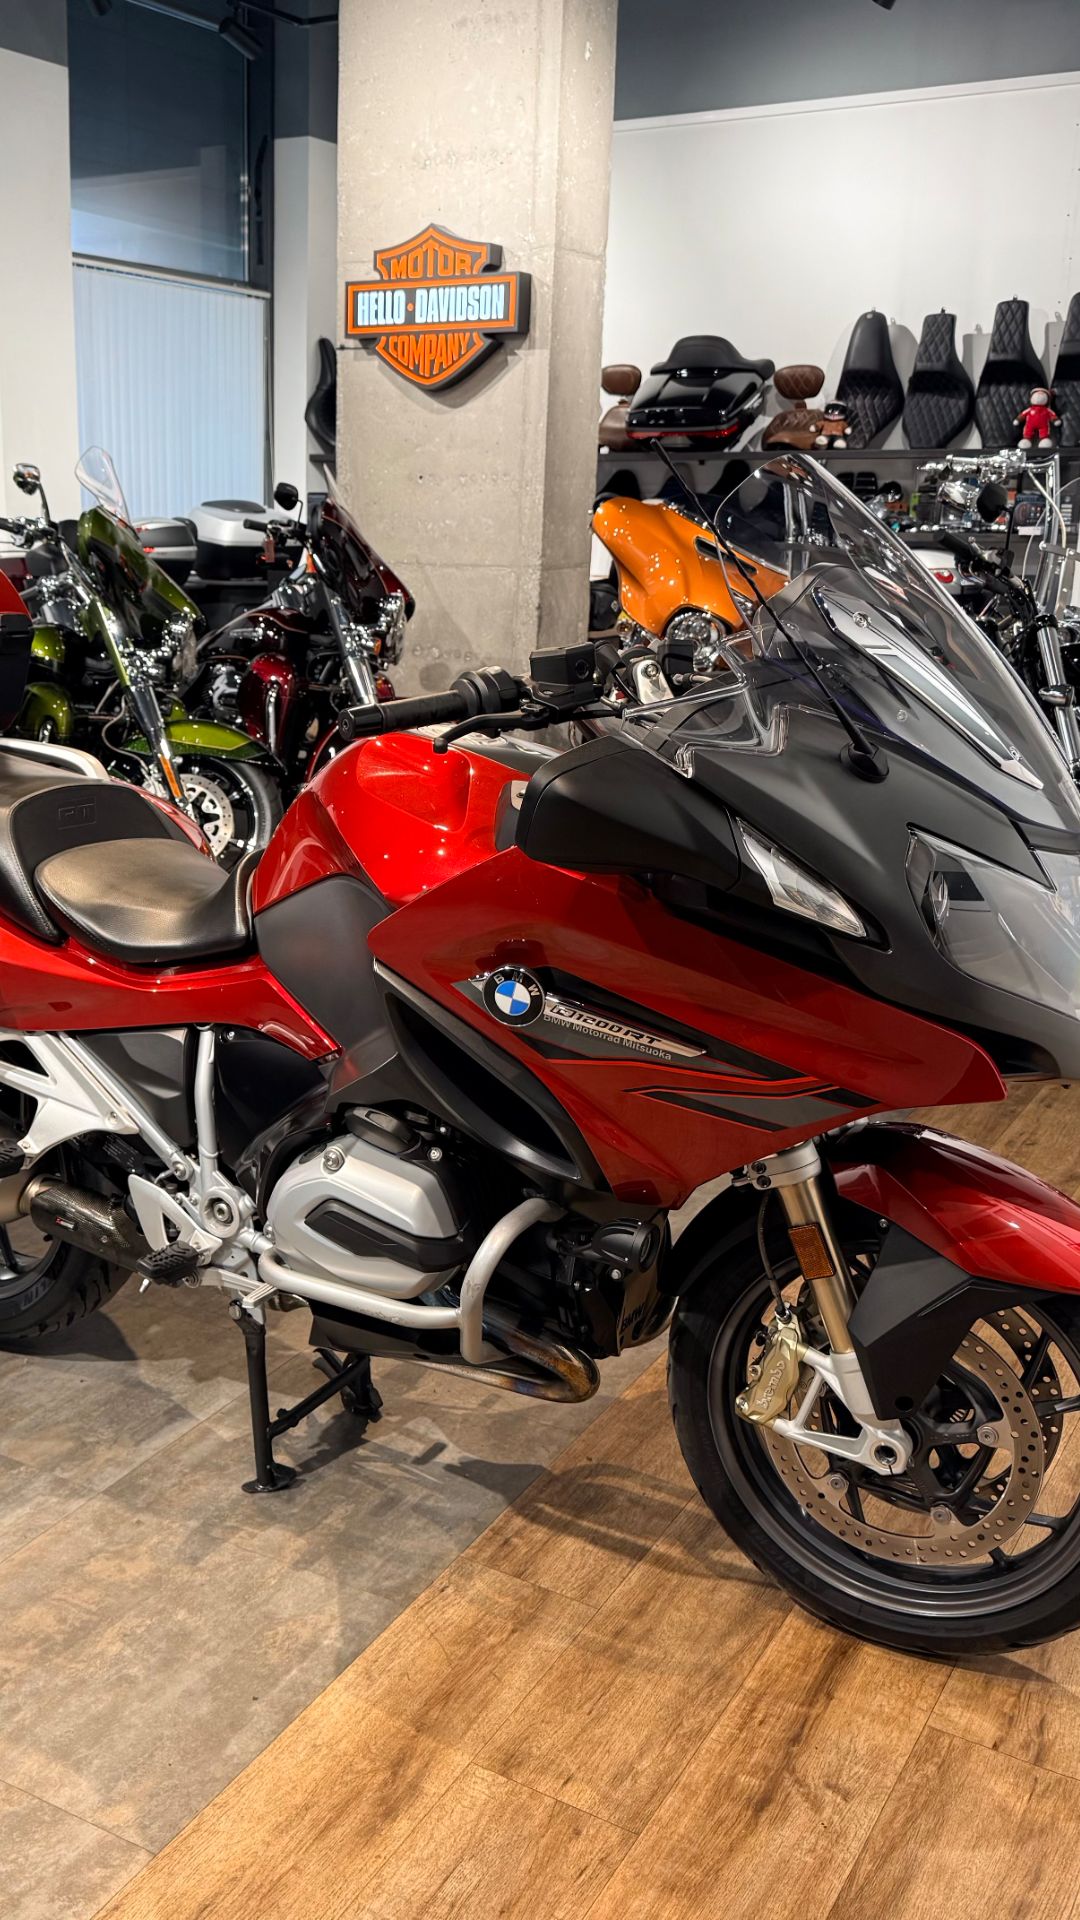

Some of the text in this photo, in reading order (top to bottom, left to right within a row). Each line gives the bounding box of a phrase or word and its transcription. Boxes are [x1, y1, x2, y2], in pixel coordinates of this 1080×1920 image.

[390, 237, 473, 280] MOTOR
[357, 284, 505, 326] HELLO DAVIDSON
[388, 331, 472, 377] COMPANY
[493, 970, 540, 996] BMW
[543, 1013, 672, 1061] BMW Motorrad Mitsuoka
[755, 1359, 785, 1410] brembo
